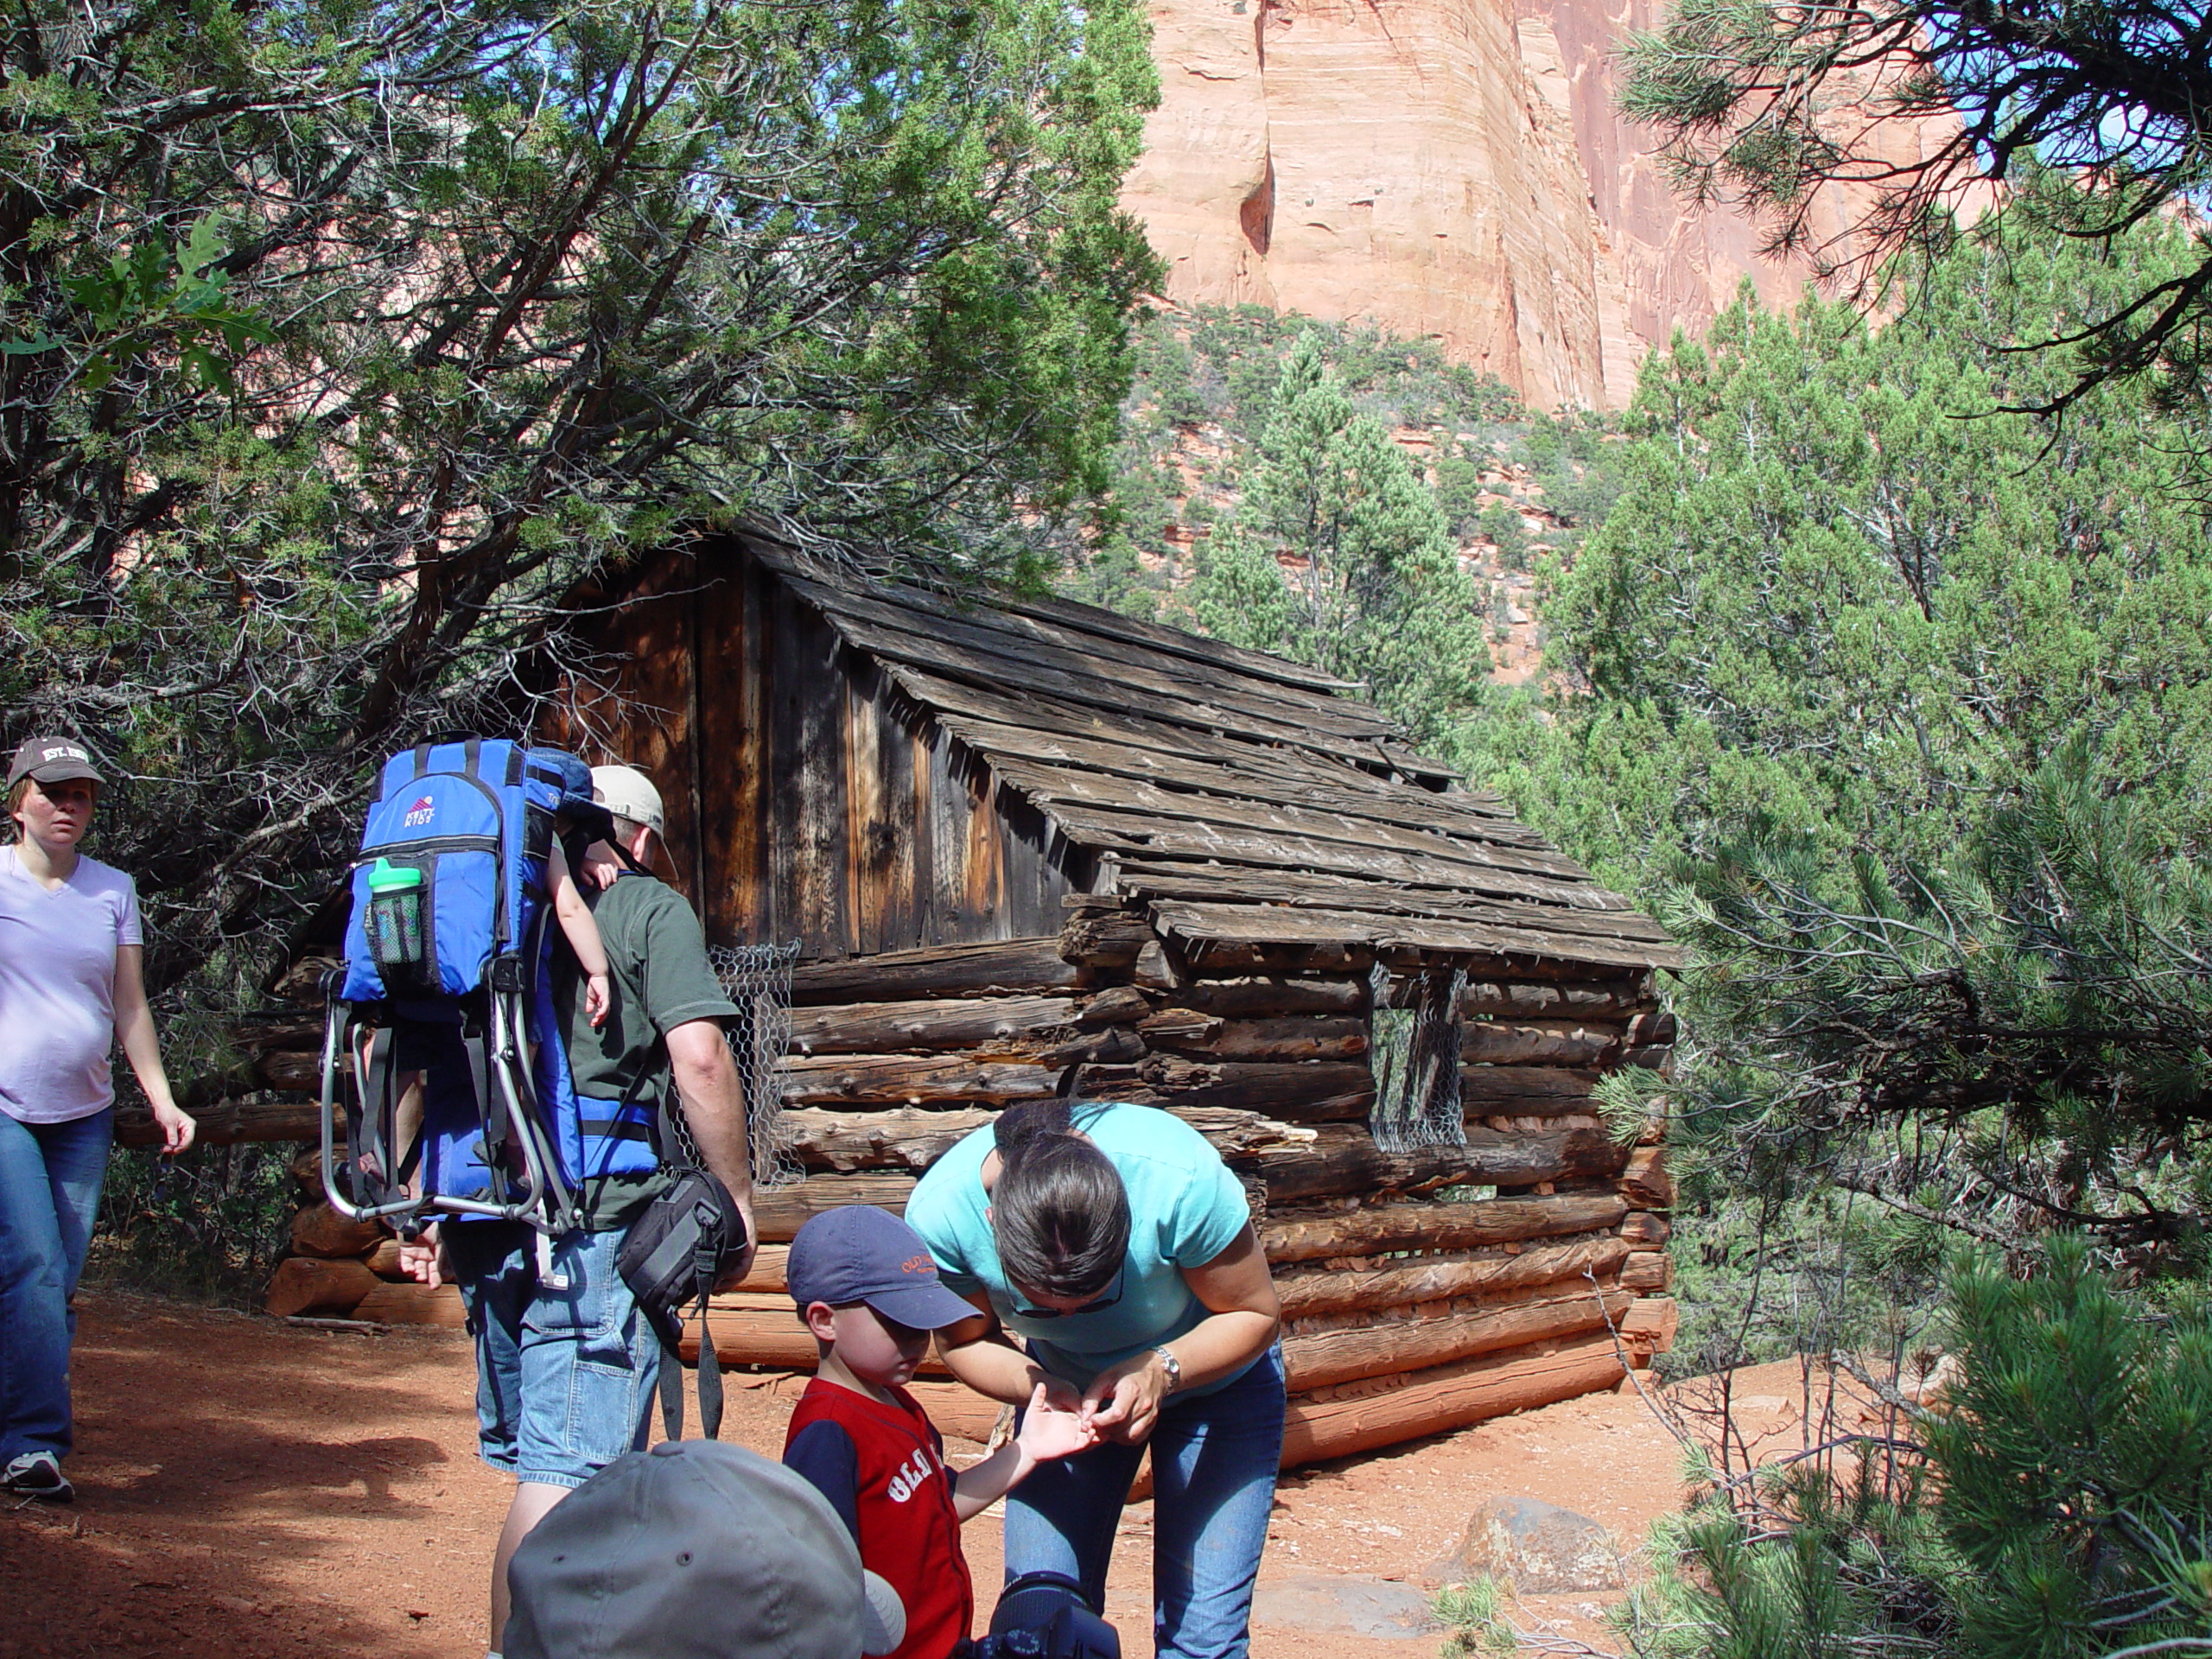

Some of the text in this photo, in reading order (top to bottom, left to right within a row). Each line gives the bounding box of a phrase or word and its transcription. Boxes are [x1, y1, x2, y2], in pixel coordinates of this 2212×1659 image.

[406, 807, 435, 820] KELTY
[404, 816, 431, 828] KIDS
[902, 1255, 922, 1274] OLD
